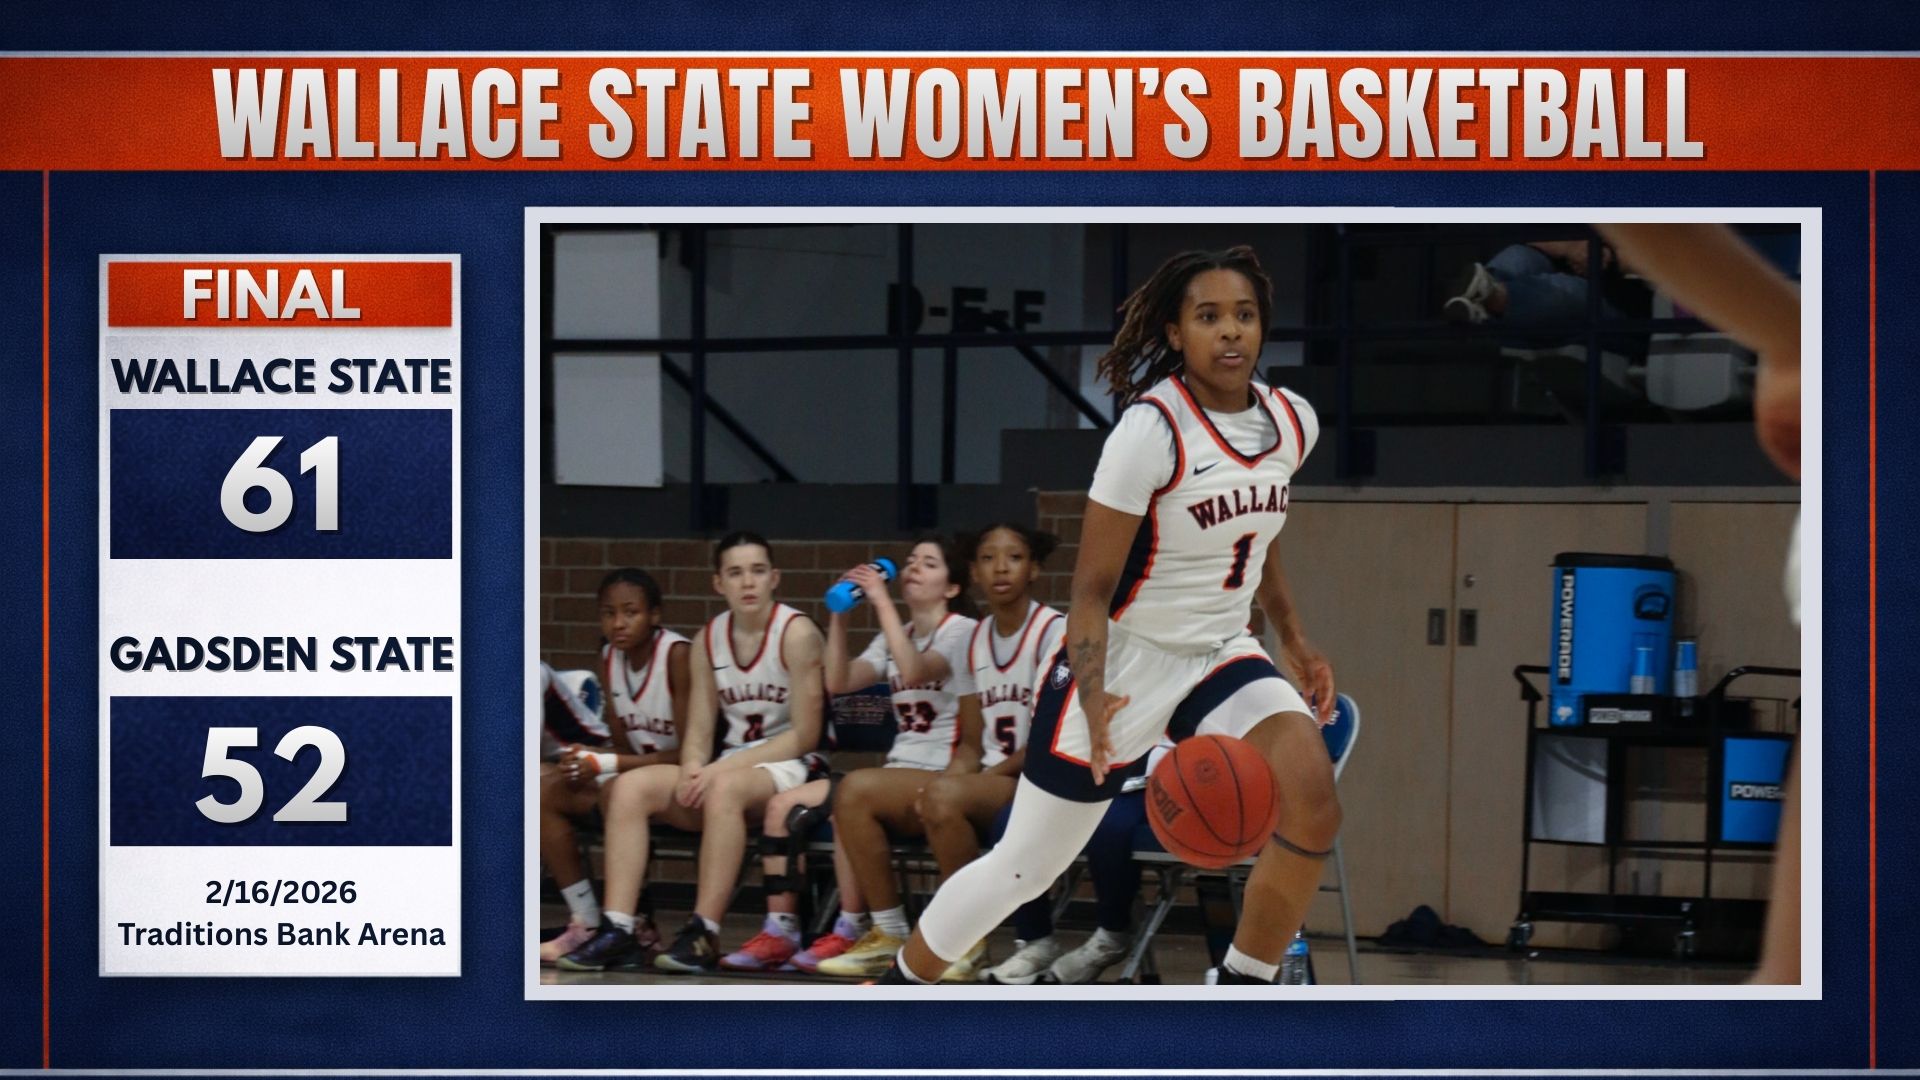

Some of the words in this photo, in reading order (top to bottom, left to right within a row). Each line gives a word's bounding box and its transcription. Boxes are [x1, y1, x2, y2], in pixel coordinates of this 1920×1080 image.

[1222, 532, 1257, 591] 1
[1558, 574, 1575, 679] POWERADE
[995, 716, 1016, 756] 5
